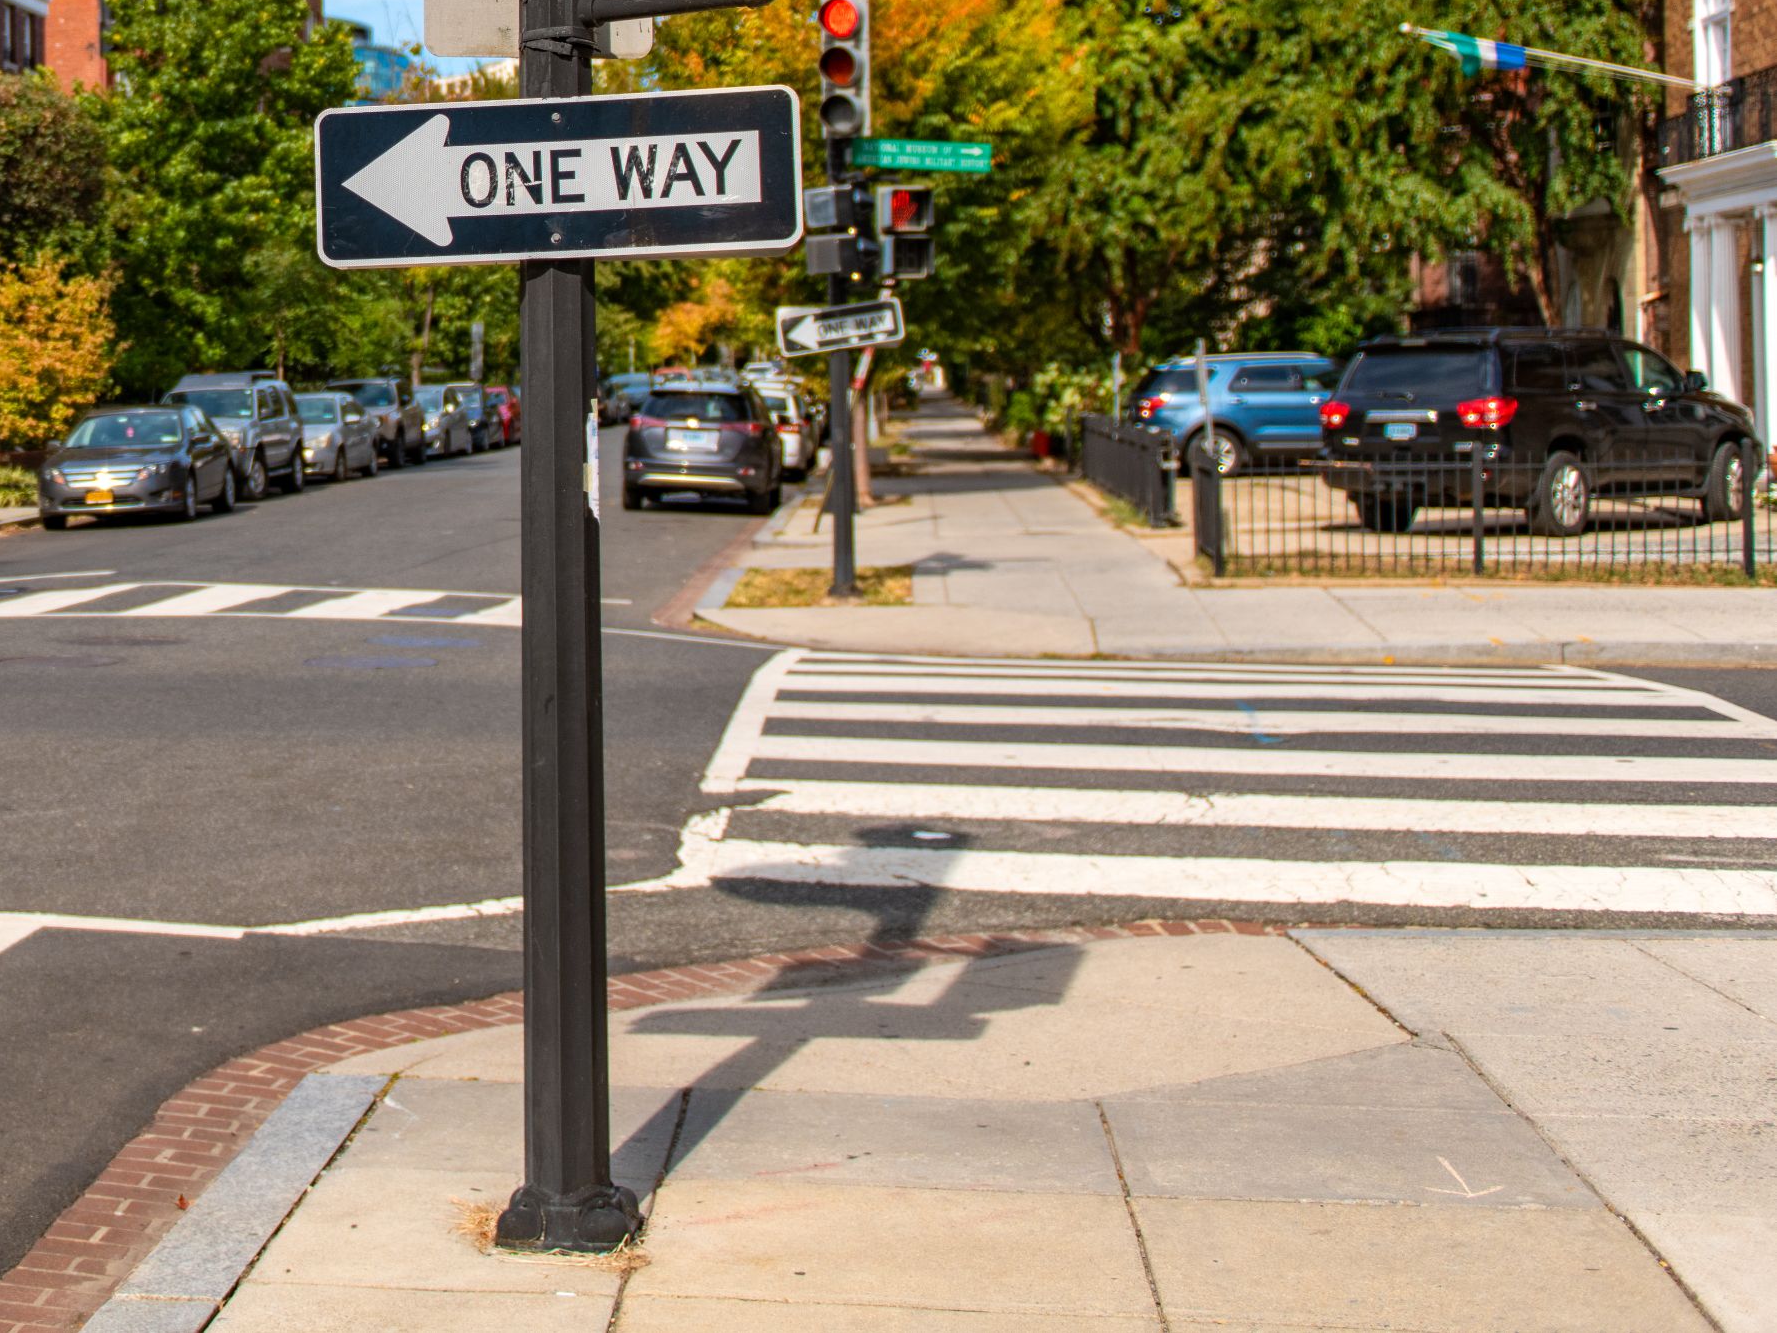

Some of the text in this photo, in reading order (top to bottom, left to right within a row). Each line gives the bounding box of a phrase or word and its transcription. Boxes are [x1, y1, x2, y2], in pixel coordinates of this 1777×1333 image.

[459, 138, 743, 209] ONE WAY
[817, 314, 887, 339] ONE WAY
